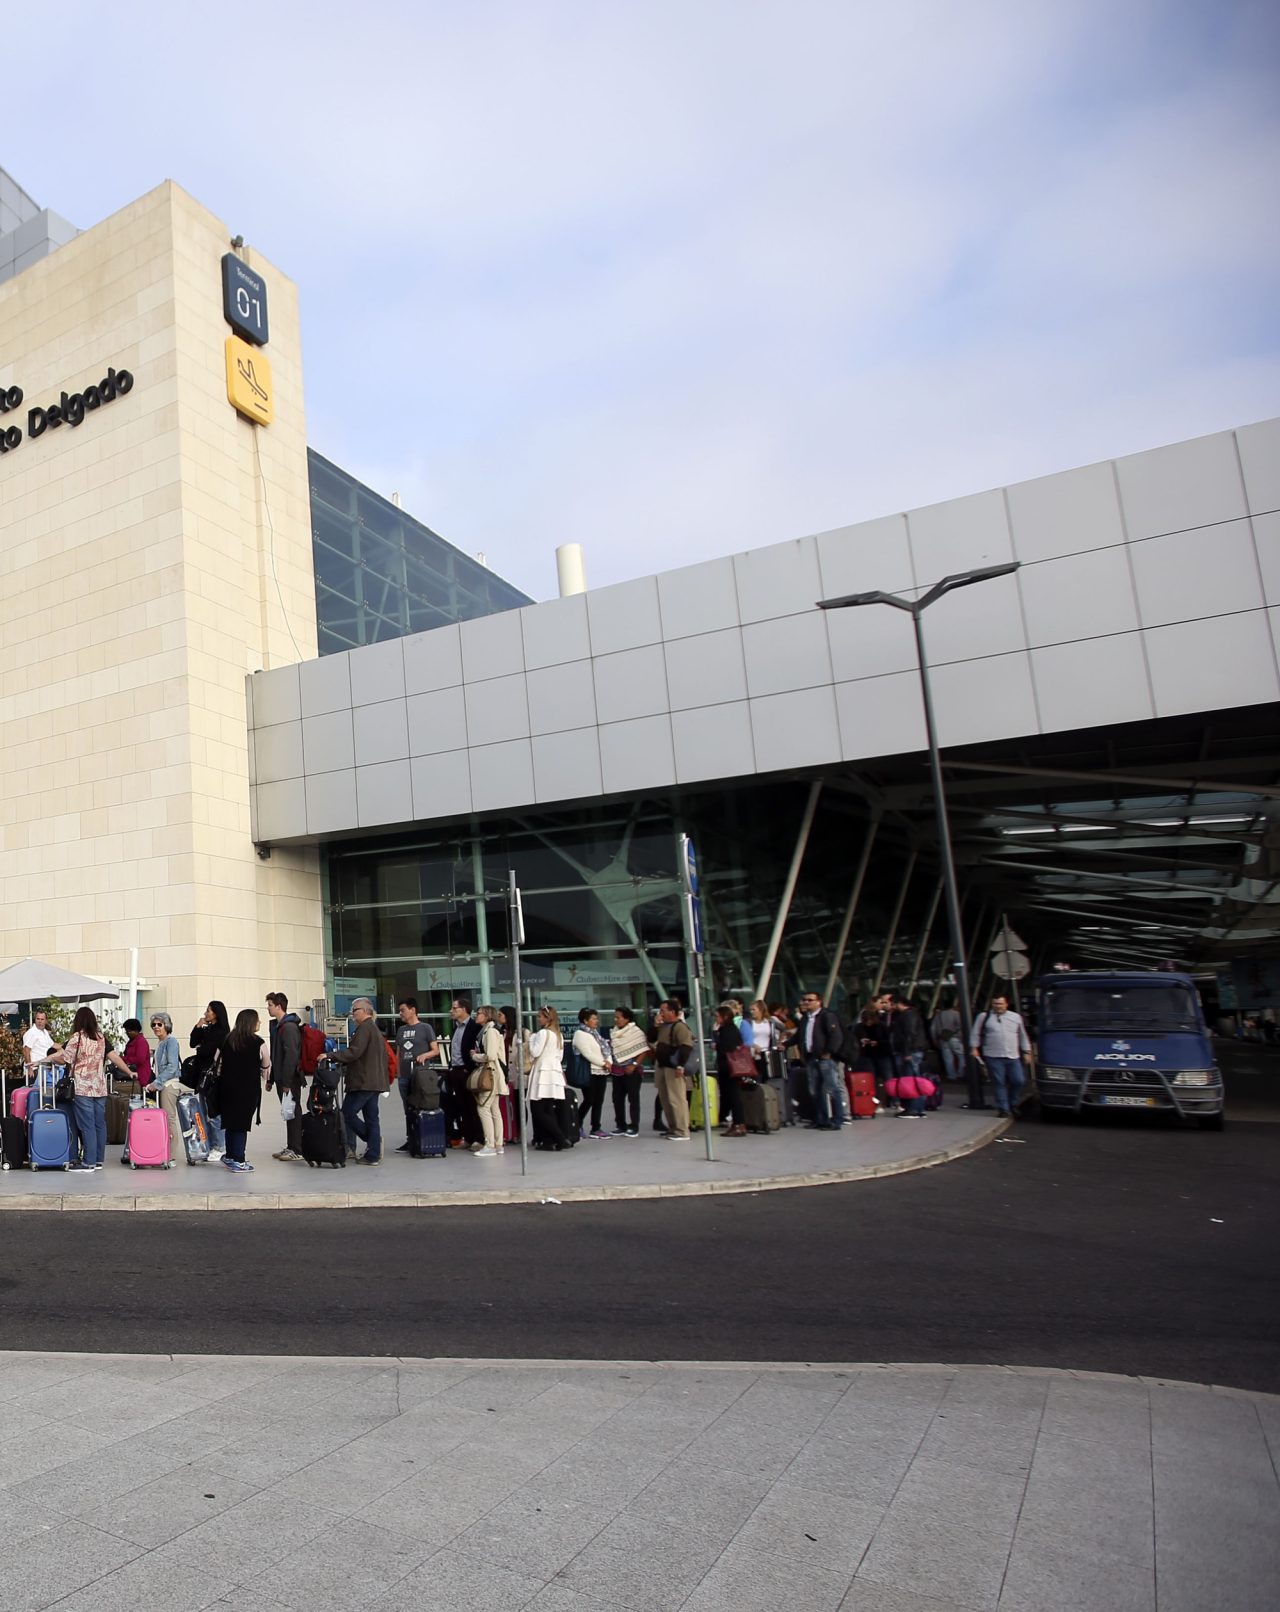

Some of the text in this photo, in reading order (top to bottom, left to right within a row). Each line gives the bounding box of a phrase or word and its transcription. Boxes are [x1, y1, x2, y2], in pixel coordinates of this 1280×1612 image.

[236, 266, 260, 291] Terminal
[236, 287, 262, 329] 01
[27, 367, 134, 439] Delgado
